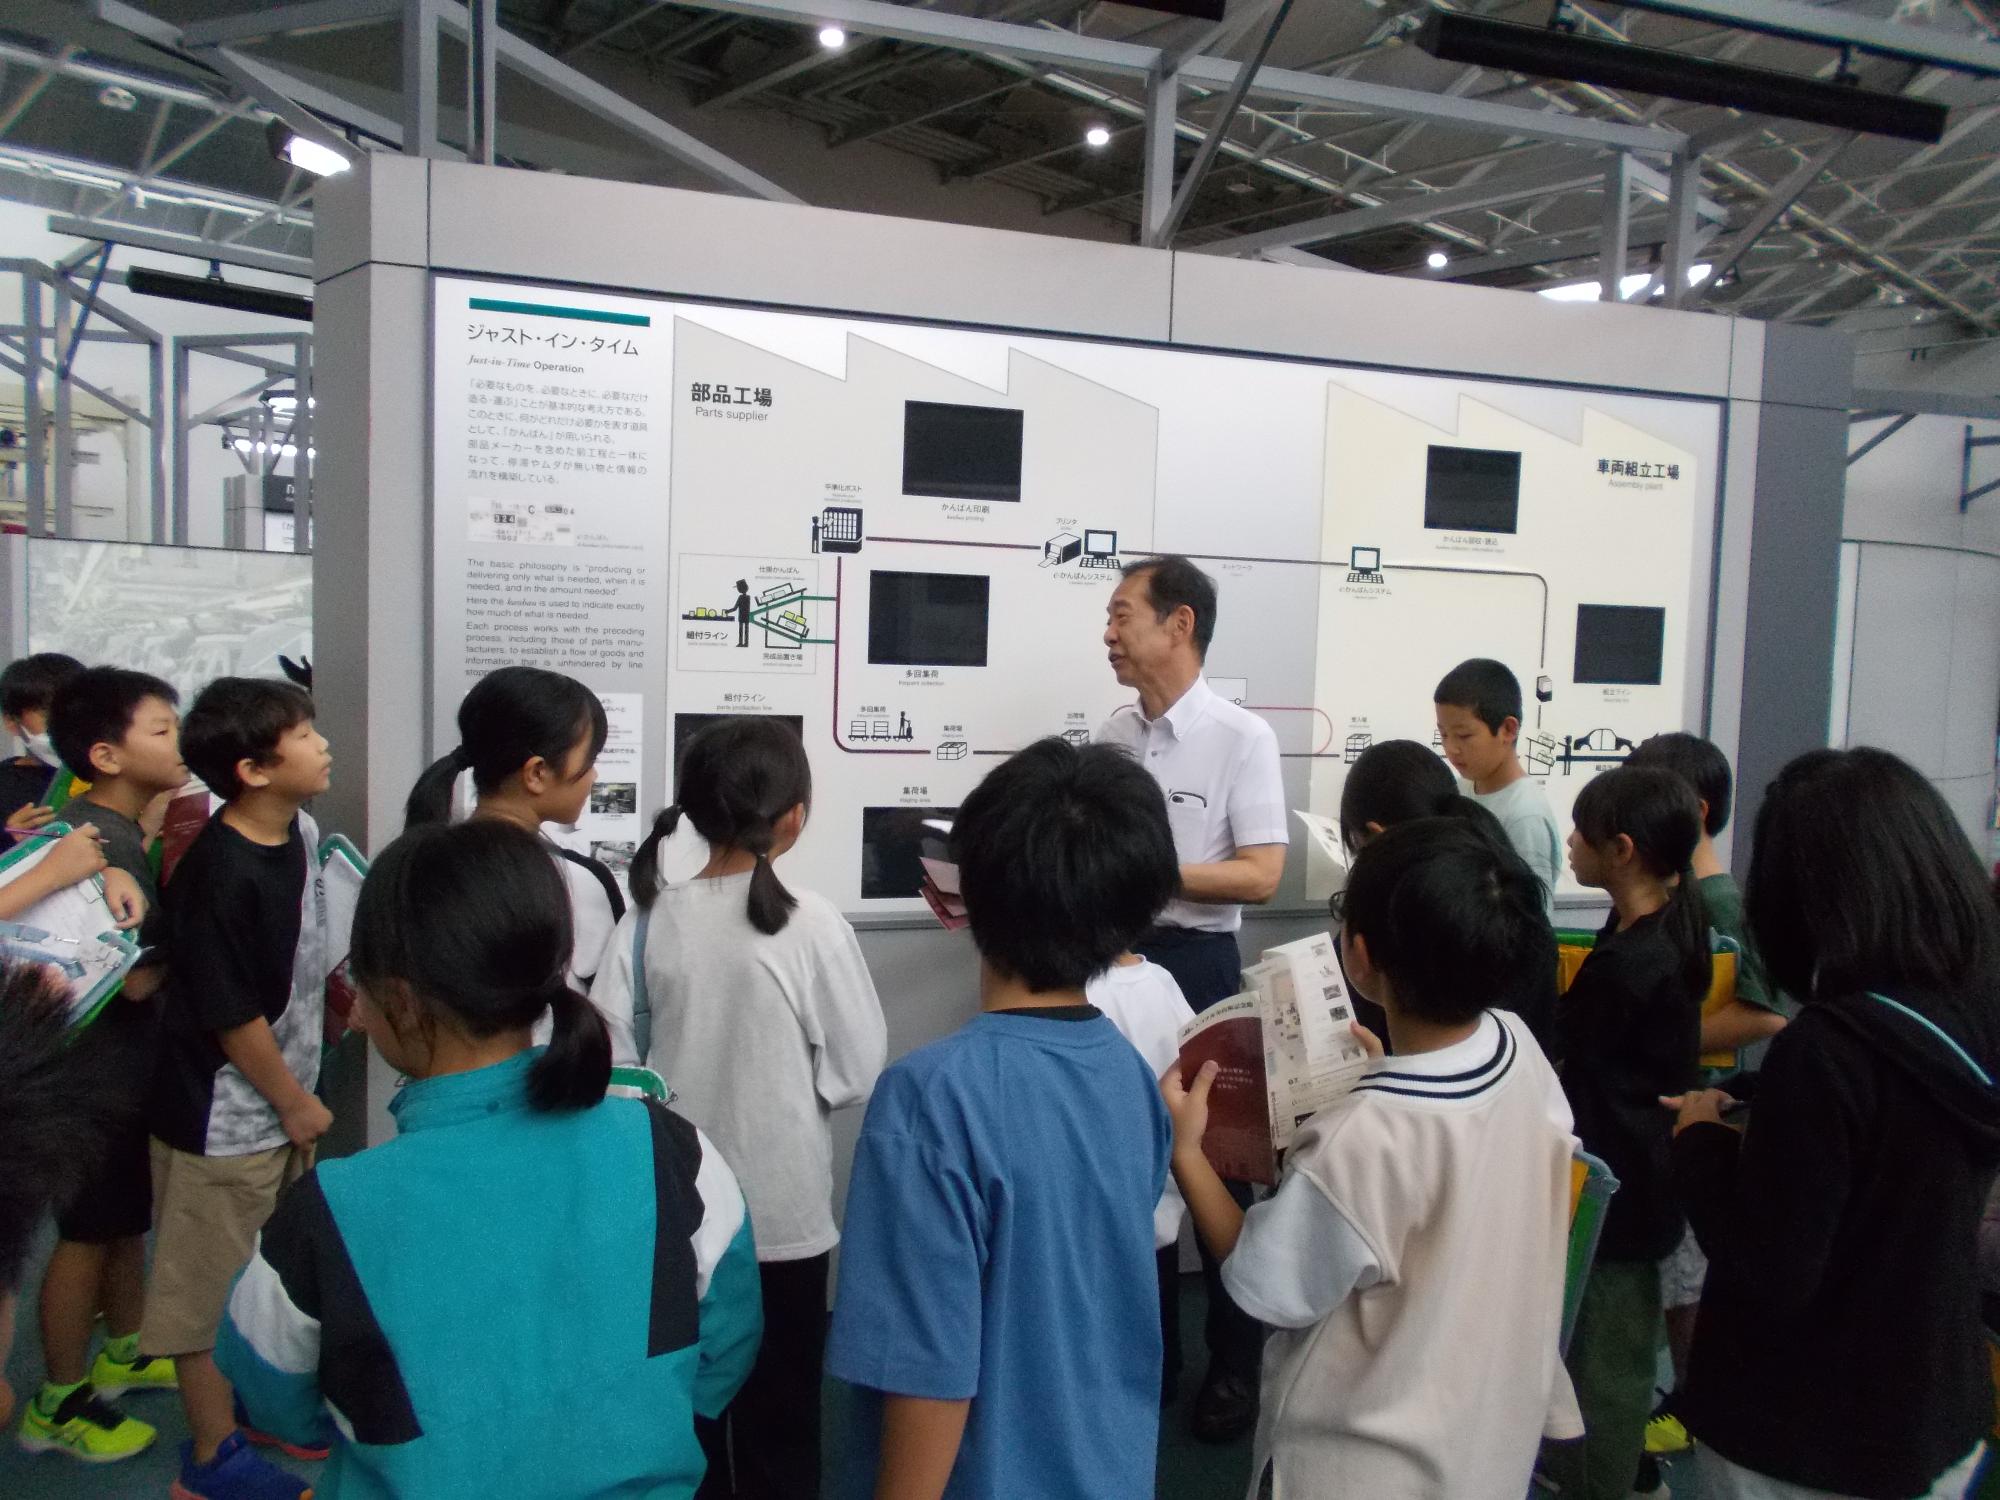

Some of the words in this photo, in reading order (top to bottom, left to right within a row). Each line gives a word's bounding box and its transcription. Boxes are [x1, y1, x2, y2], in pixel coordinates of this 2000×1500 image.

[467, 324, 639, 356] ジャスト・イン・タイム
[468, 355, 532, 369] Just-in-Time
[533, 361, 585, 374] Operation
[691, 382, 773, 407] 部品工場
[695, 406, 724, 419] Parts
[726, 409, 768, 422] supplier
[1597, 459, 1680, 480] 車両組立工場
[1608, 479, 1643, 491] Assembly
[942, 503, 990, 514] かんばん印刷
[467, 558, 484, 567] The
[490, 560, 514, 568] basic
[519, 561, 567, 571] philosophy
[467, 571, 509, 581] delivering
[512, 573, 530, 582] only
[466, 596, 488, 604] Here
[616, 603, 645, 611] exactly
[466, 621, 490, 629] Each
[603, 628, 645, 636] preceding
[509, 636, 547, 645] including
[686, 631, 729, 640] 組付ライン
[465, 657, 514, 665] information
[612, 661, 621, 669] by
[905, 670, 940, 679] 多回集荷
[723, 693, 766, 703] 組付ライン
[903, 786, 929, 795] 集荷場
